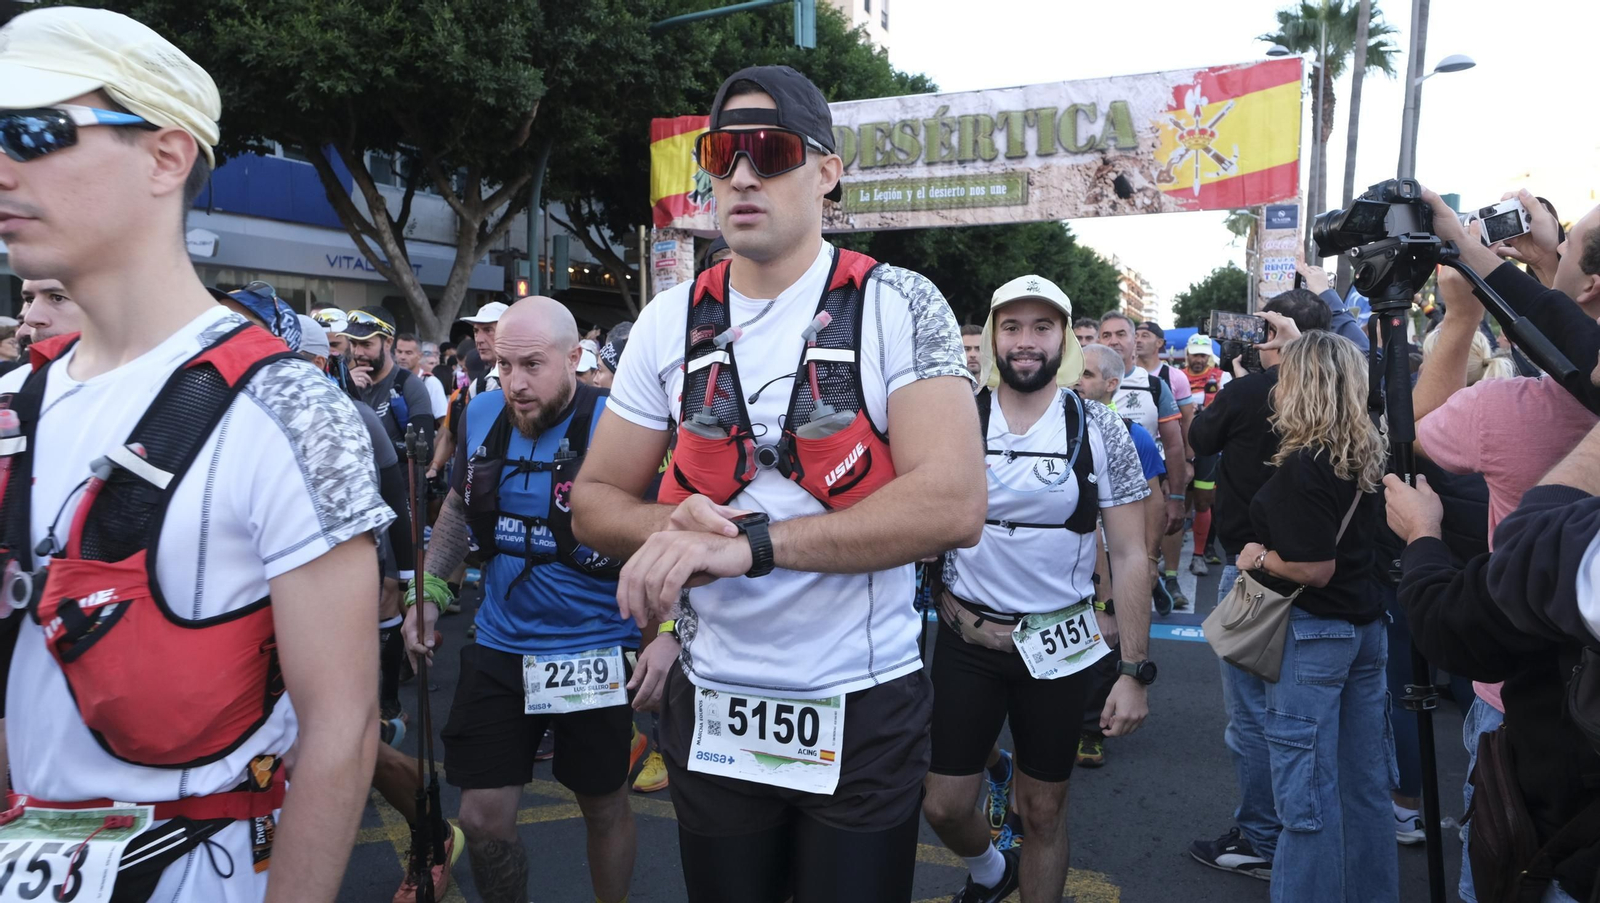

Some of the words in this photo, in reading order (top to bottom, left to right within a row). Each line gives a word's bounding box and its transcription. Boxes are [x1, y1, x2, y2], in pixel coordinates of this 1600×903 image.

[832, 99, 1139, 170] DESÉRTICA
[859, 189, 870, 202] La
[873, 187, 903, 203] Legión
[906, 190, 913, 201] y
[916, 187, 926, 200] el
[929, 185, 966, 199] desierto
[969, 185, 986, 196] nos
[989, 183, 1007, 195] une
[1264, 263, 1295, 271] RENTA
[1039, 614, 1091, 655] 5151
[544, 657, 609, 689] 2259
[696, 721, 704, 746] MARCHA
[727, 696, 820, 748] 5150
[797, 748, 818, 757] ACING
[0, 841, 91, 902] 153
